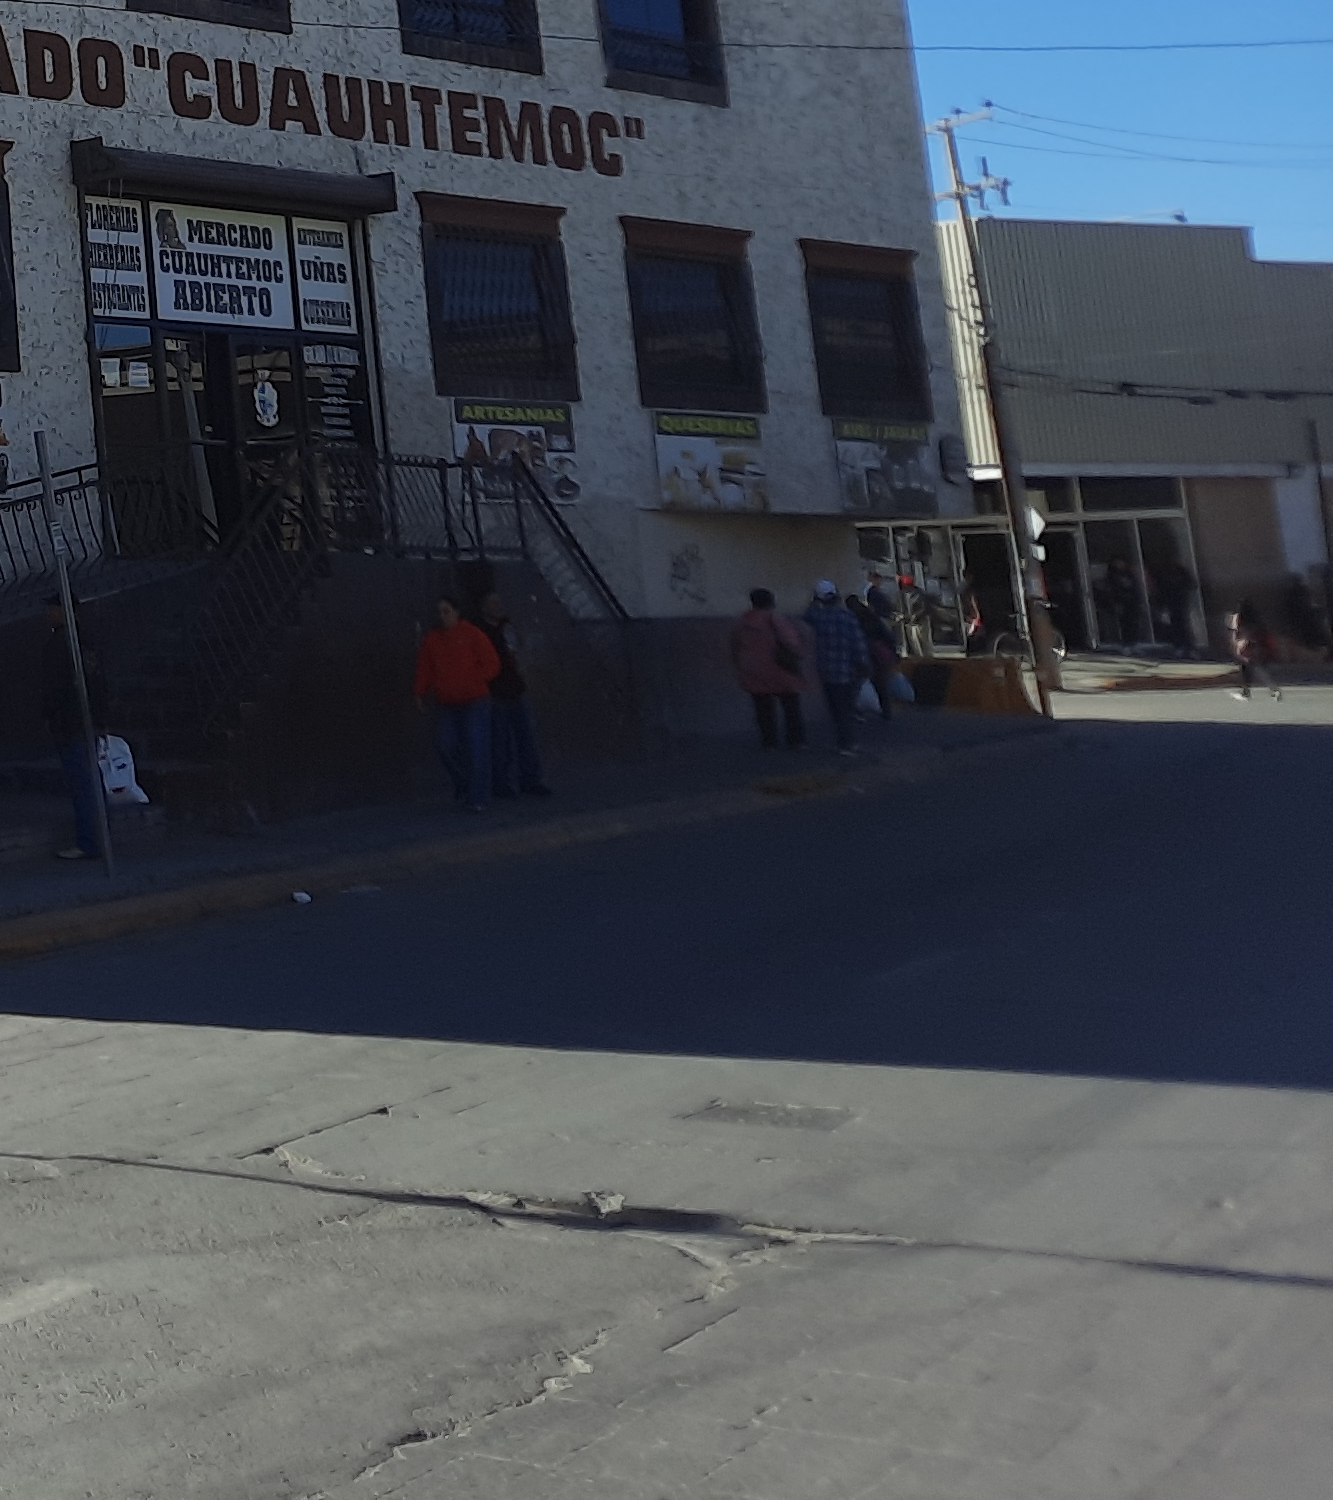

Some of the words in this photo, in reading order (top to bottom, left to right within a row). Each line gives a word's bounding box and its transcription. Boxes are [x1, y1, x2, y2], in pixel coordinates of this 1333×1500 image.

[133, 45, 645, 176] "CUAUHTEMOC"
[186, 218, 273, 251] MERCADO
[159, 249, 284, 284] CUAUHTEMOC
[300, 255, 347, 284] UÑAS
[173, 279, 272, 318] ABIERTO
[462, 404, 566, 422] ARTESANIAS
